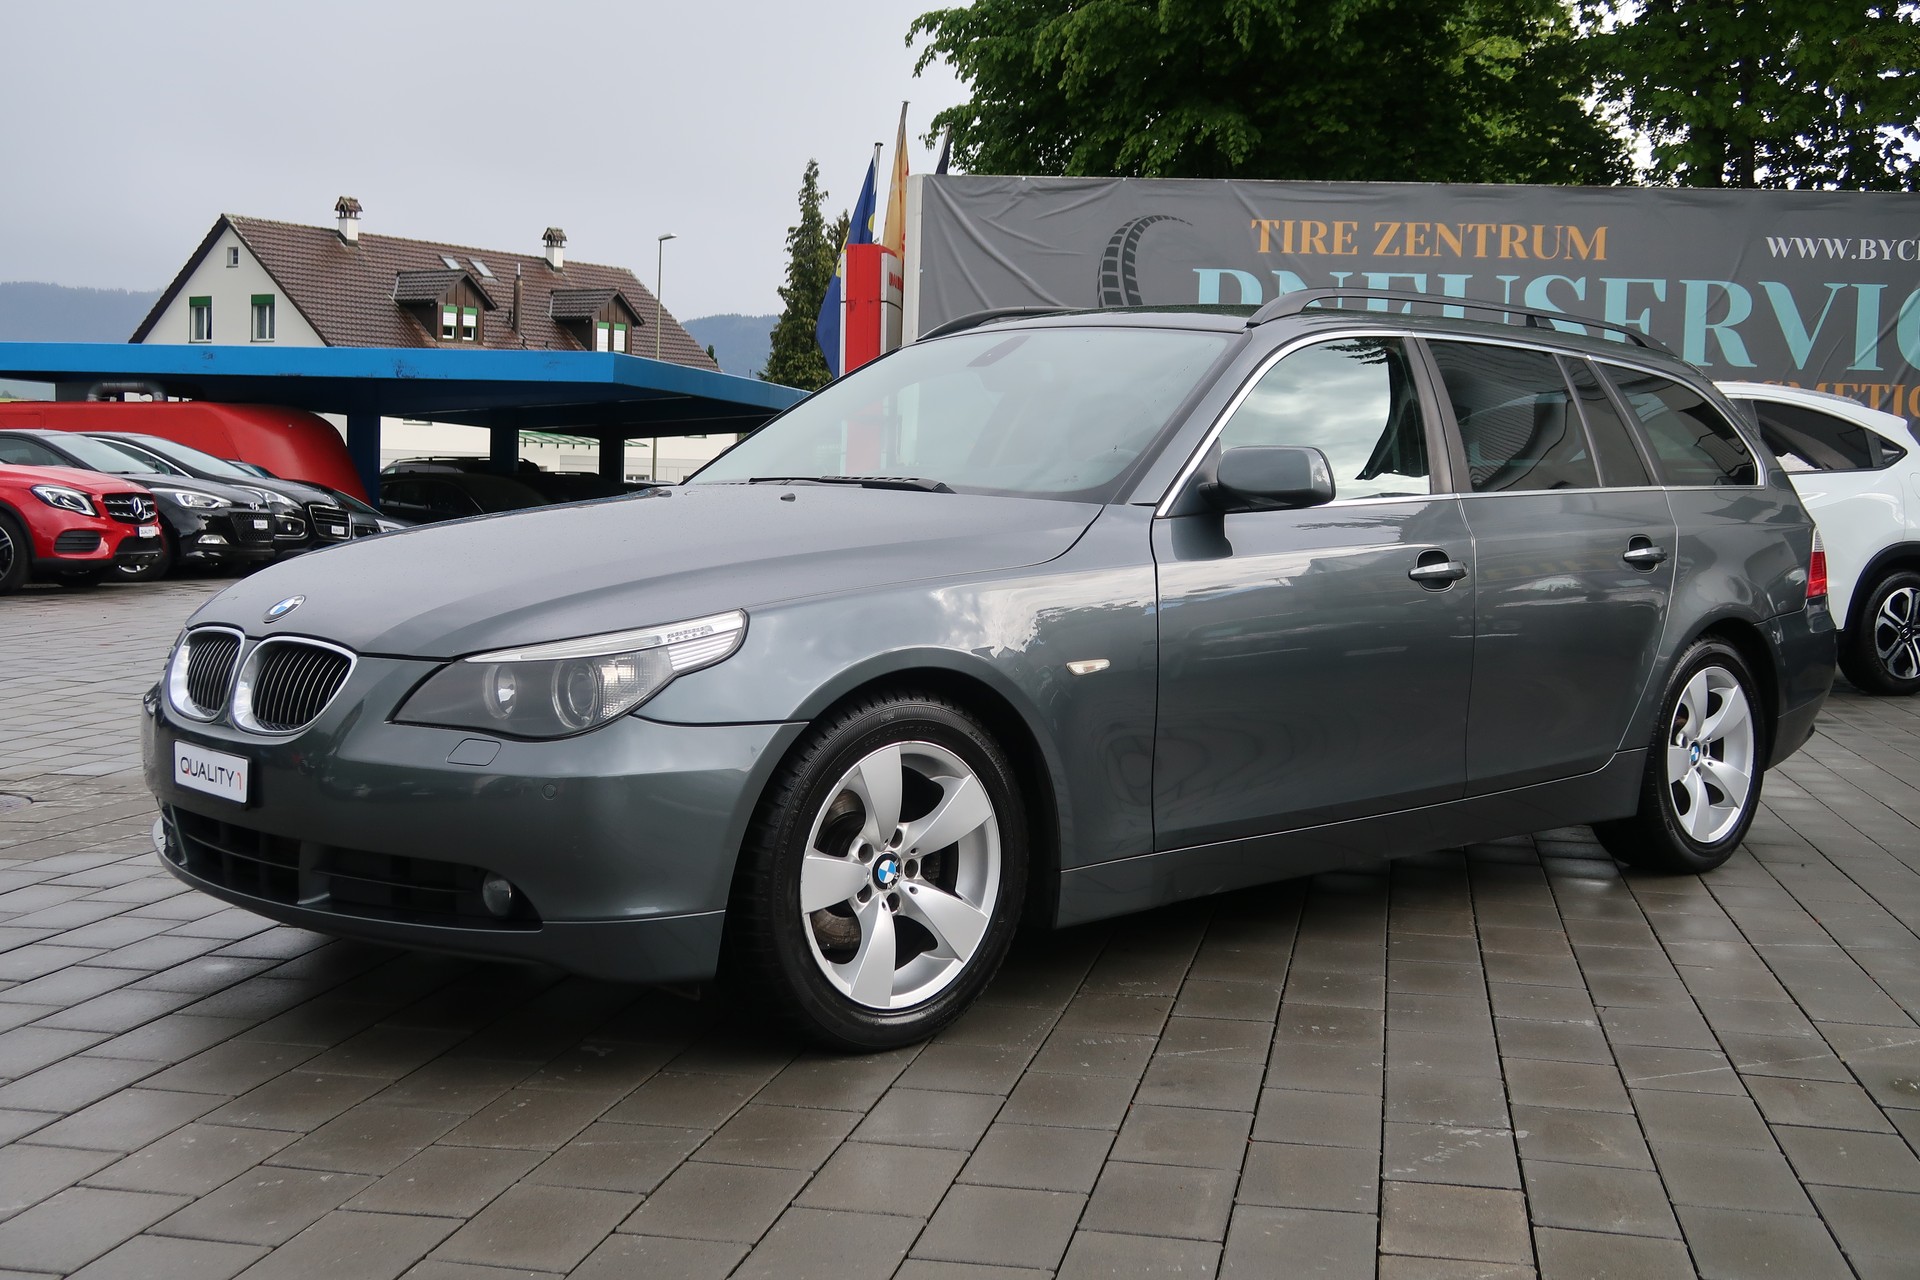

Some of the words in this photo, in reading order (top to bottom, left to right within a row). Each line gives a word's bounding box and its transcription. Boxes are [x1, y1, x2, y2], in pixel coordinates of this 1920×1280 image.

[1251, 219, 1358, 255] TIRE
[1374, 221, 1608, 261] ZENTRUM
[1765, 236, 1920, 262] WWW.BYC
